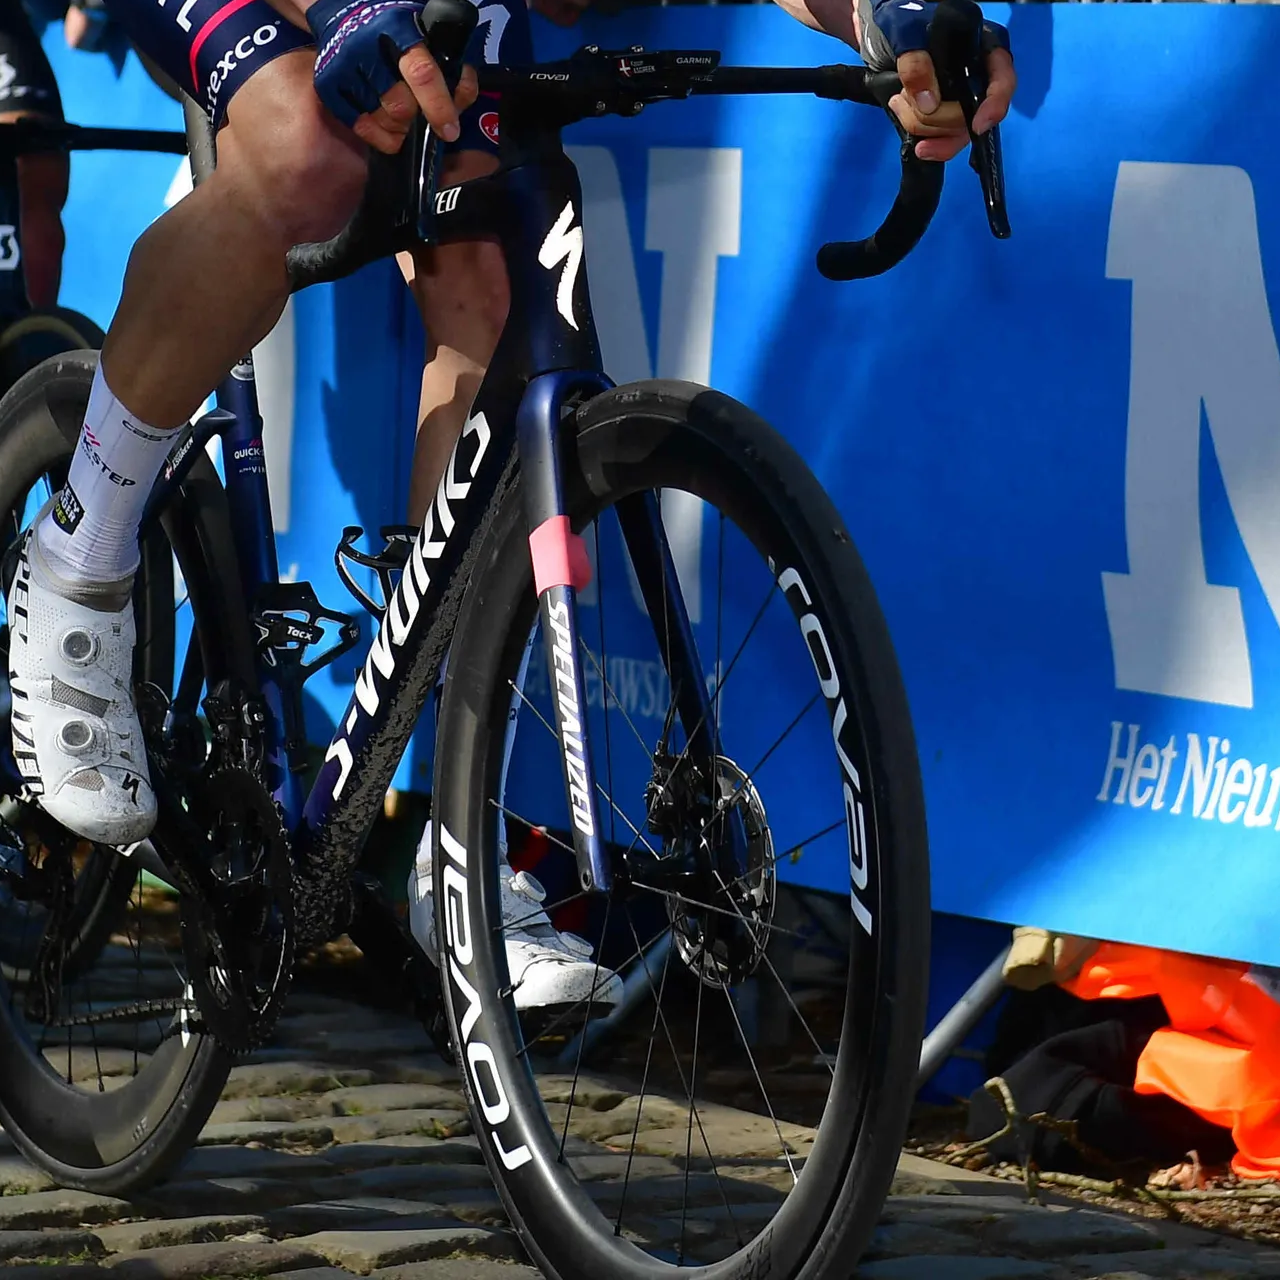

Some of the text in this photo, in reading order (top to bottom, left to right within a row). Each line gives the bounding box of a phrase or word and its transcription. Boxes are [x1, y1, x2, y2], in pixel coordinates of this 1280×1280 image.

[529, 72, 570, 82] roval
[676, 56, 712, 65] GARMIN
[287, 626, 313, 640] Tacx
[324, 411, 492, 803] S-WORKS
[547, 595, 595, 838] SPECIALIZED
[766, 556, 875, 938] roval
[1096, 720, 1176, 811] Het
[437, 821, 535, 1172] roval
